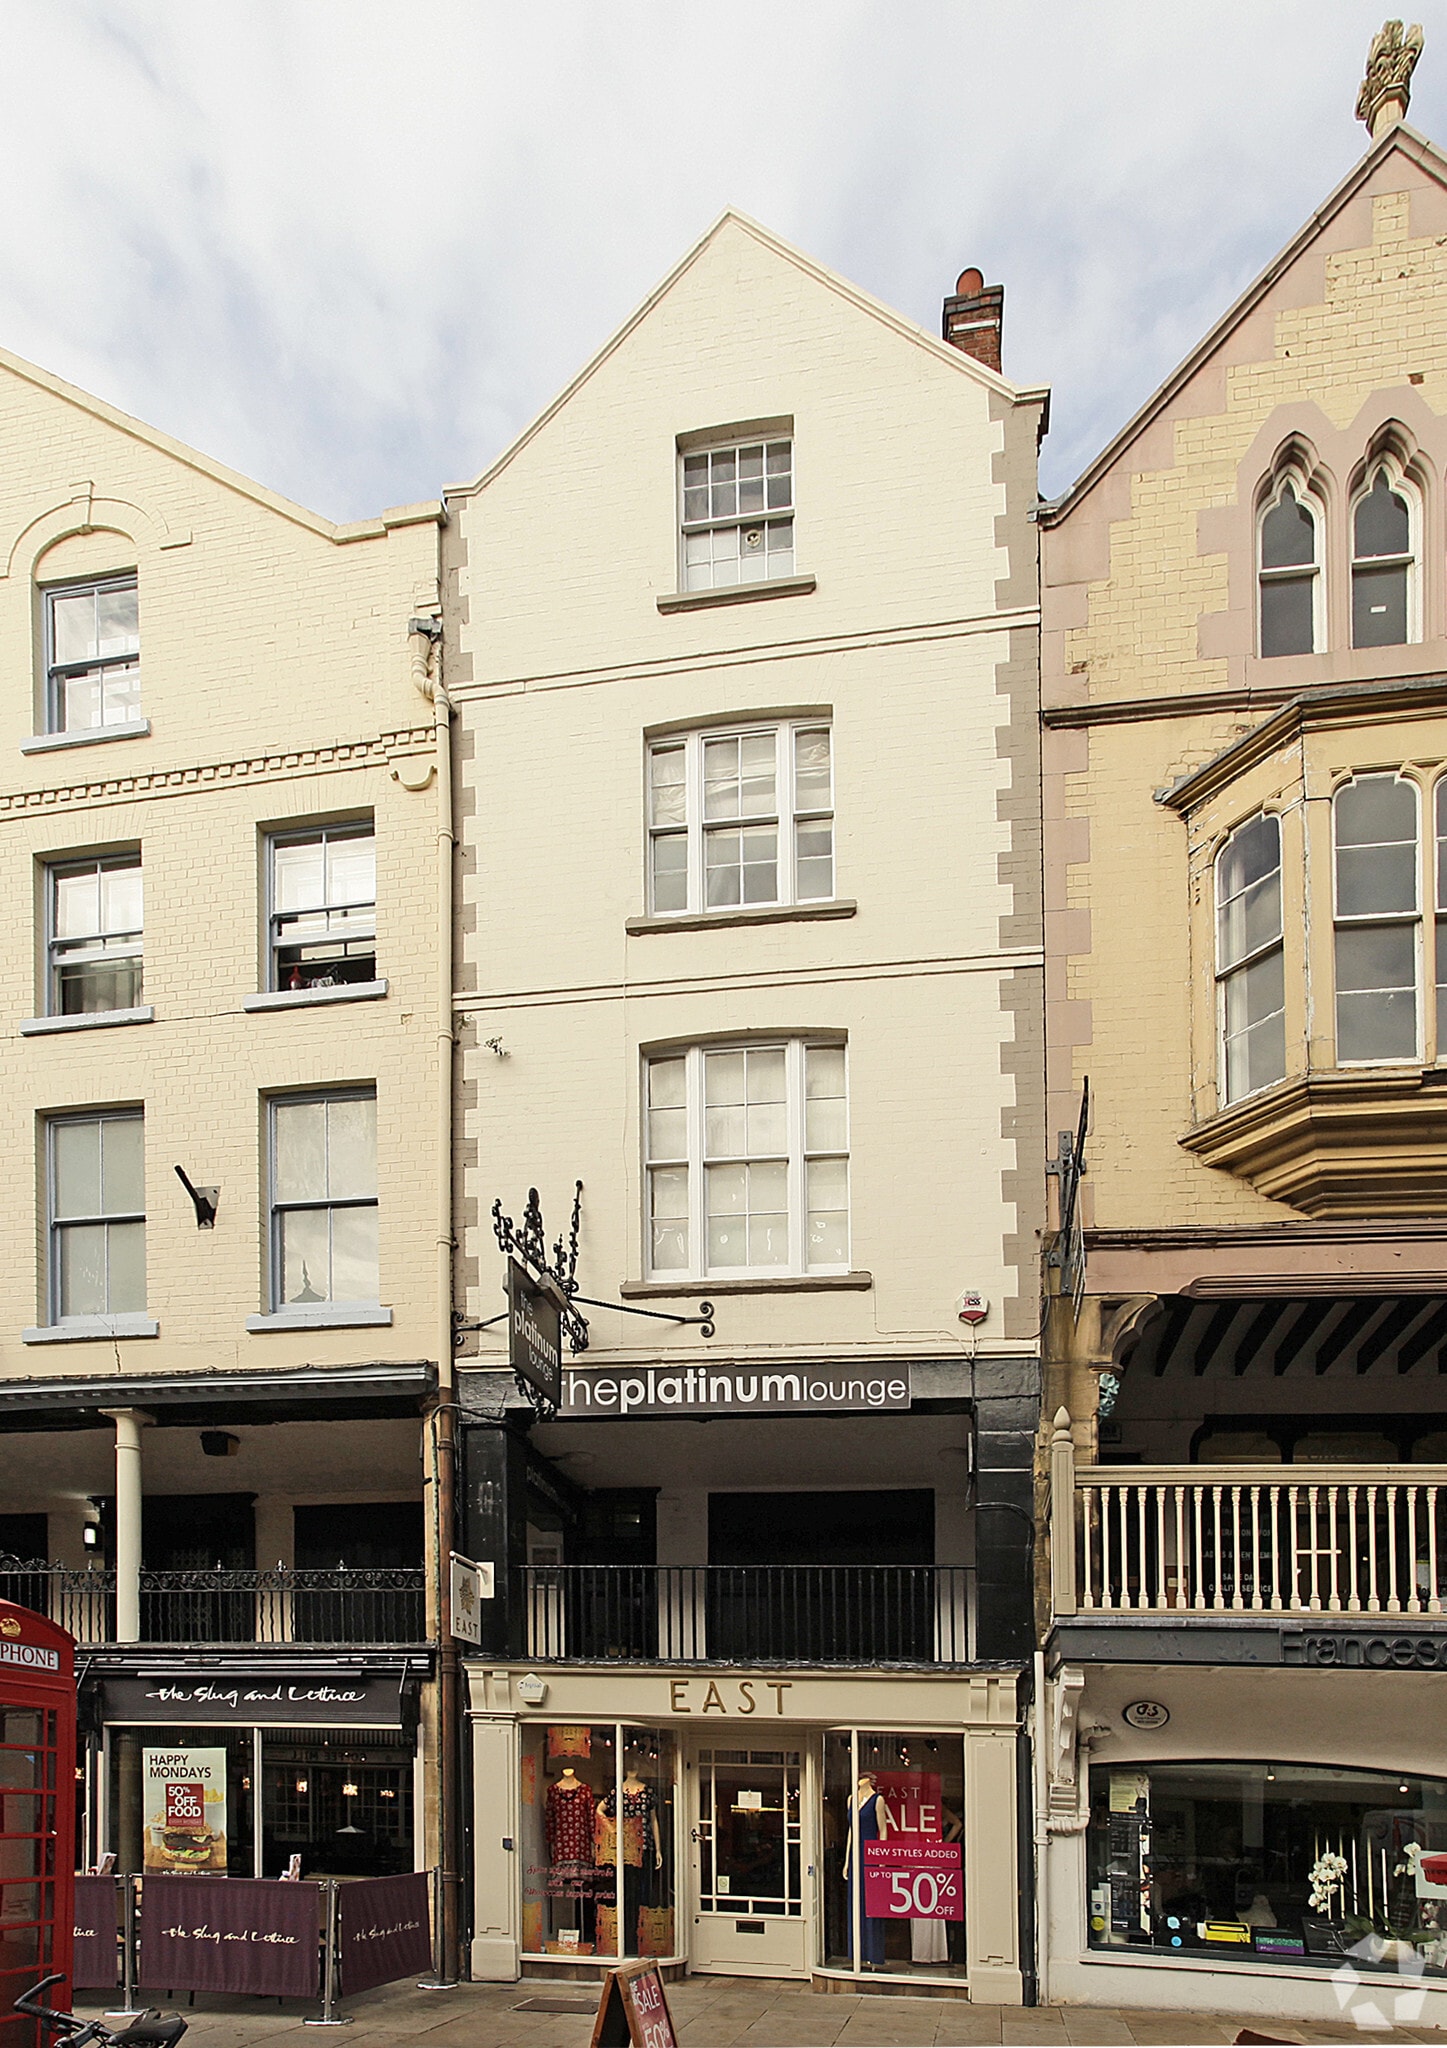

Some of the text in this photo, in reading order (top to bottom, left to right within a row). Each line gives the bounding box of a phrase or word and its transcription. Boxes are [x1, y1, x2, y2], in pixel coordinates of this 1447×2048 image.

[520, 1290, 534, 1316] the
[514, 1309, 558, 1368] platinum
[528, 1344, 554, 1381] lounge
[456, 1616, 478, 1638] EAST
[0, 1643, 56, 1667] PHONE
[145, 1683, 192, 1701] the
[243, 1685, 283, 1701] and
[288, 1686, 366, 1702] Lettuce
[670, 1680, 793, 1715] EAST
[149, 1754, 189, 1766] HAPPY
[149, 1766, 212, 1778] MONDAYS
[168, 1786, 191, 1797] 50%
[876, 1786, 921, 1799] EAST
[168, 1805, 202, 1817] FOOD
[174, 1796, 198, 1807] OFF
[884, 1804, 937, 1833] ALE
[867, 1847, 958, 1859] NEW STYLES ADDED
[889, 1872, 957, 1914] 50%
[935, 1905, 955, 1915] OFF
[161, 1925, 191, 1938] the
[223, 1930, 247, 1941] and
[251, 1931, 302, 1944] Lettuce
[636, 1984, 661, 2015] SALE
